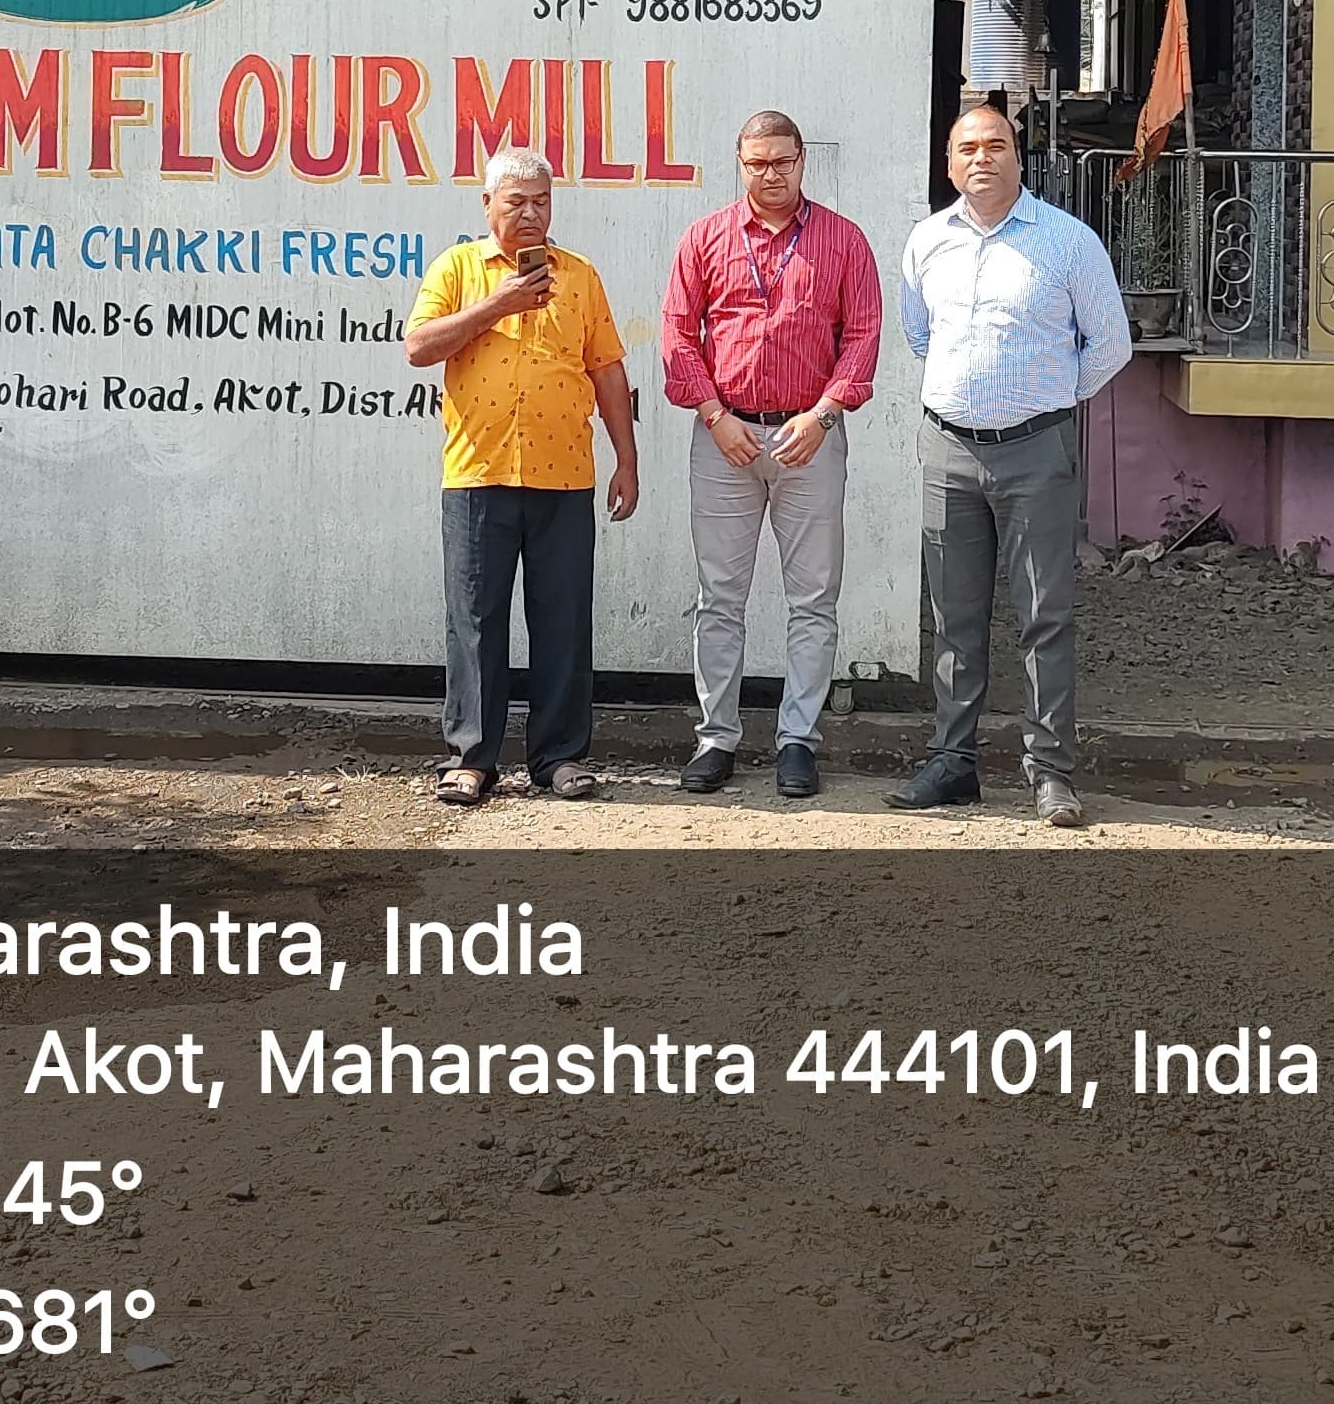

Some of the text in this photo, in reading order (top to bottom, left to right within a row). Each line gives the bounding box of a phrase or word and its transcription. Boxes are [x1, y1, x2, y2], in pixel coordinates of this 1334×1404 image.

[89, 48, 440, 186] FLOUR
[451, 56, 703, 189] MILL
[80, 225, 262, 275] CHAKKI
[282, 229, 424, 280] FRESH
[103, 301, 155, 337] B-6
[166, 303, 250, 341] MIDC
[257, 306, 325, 343] Mini
